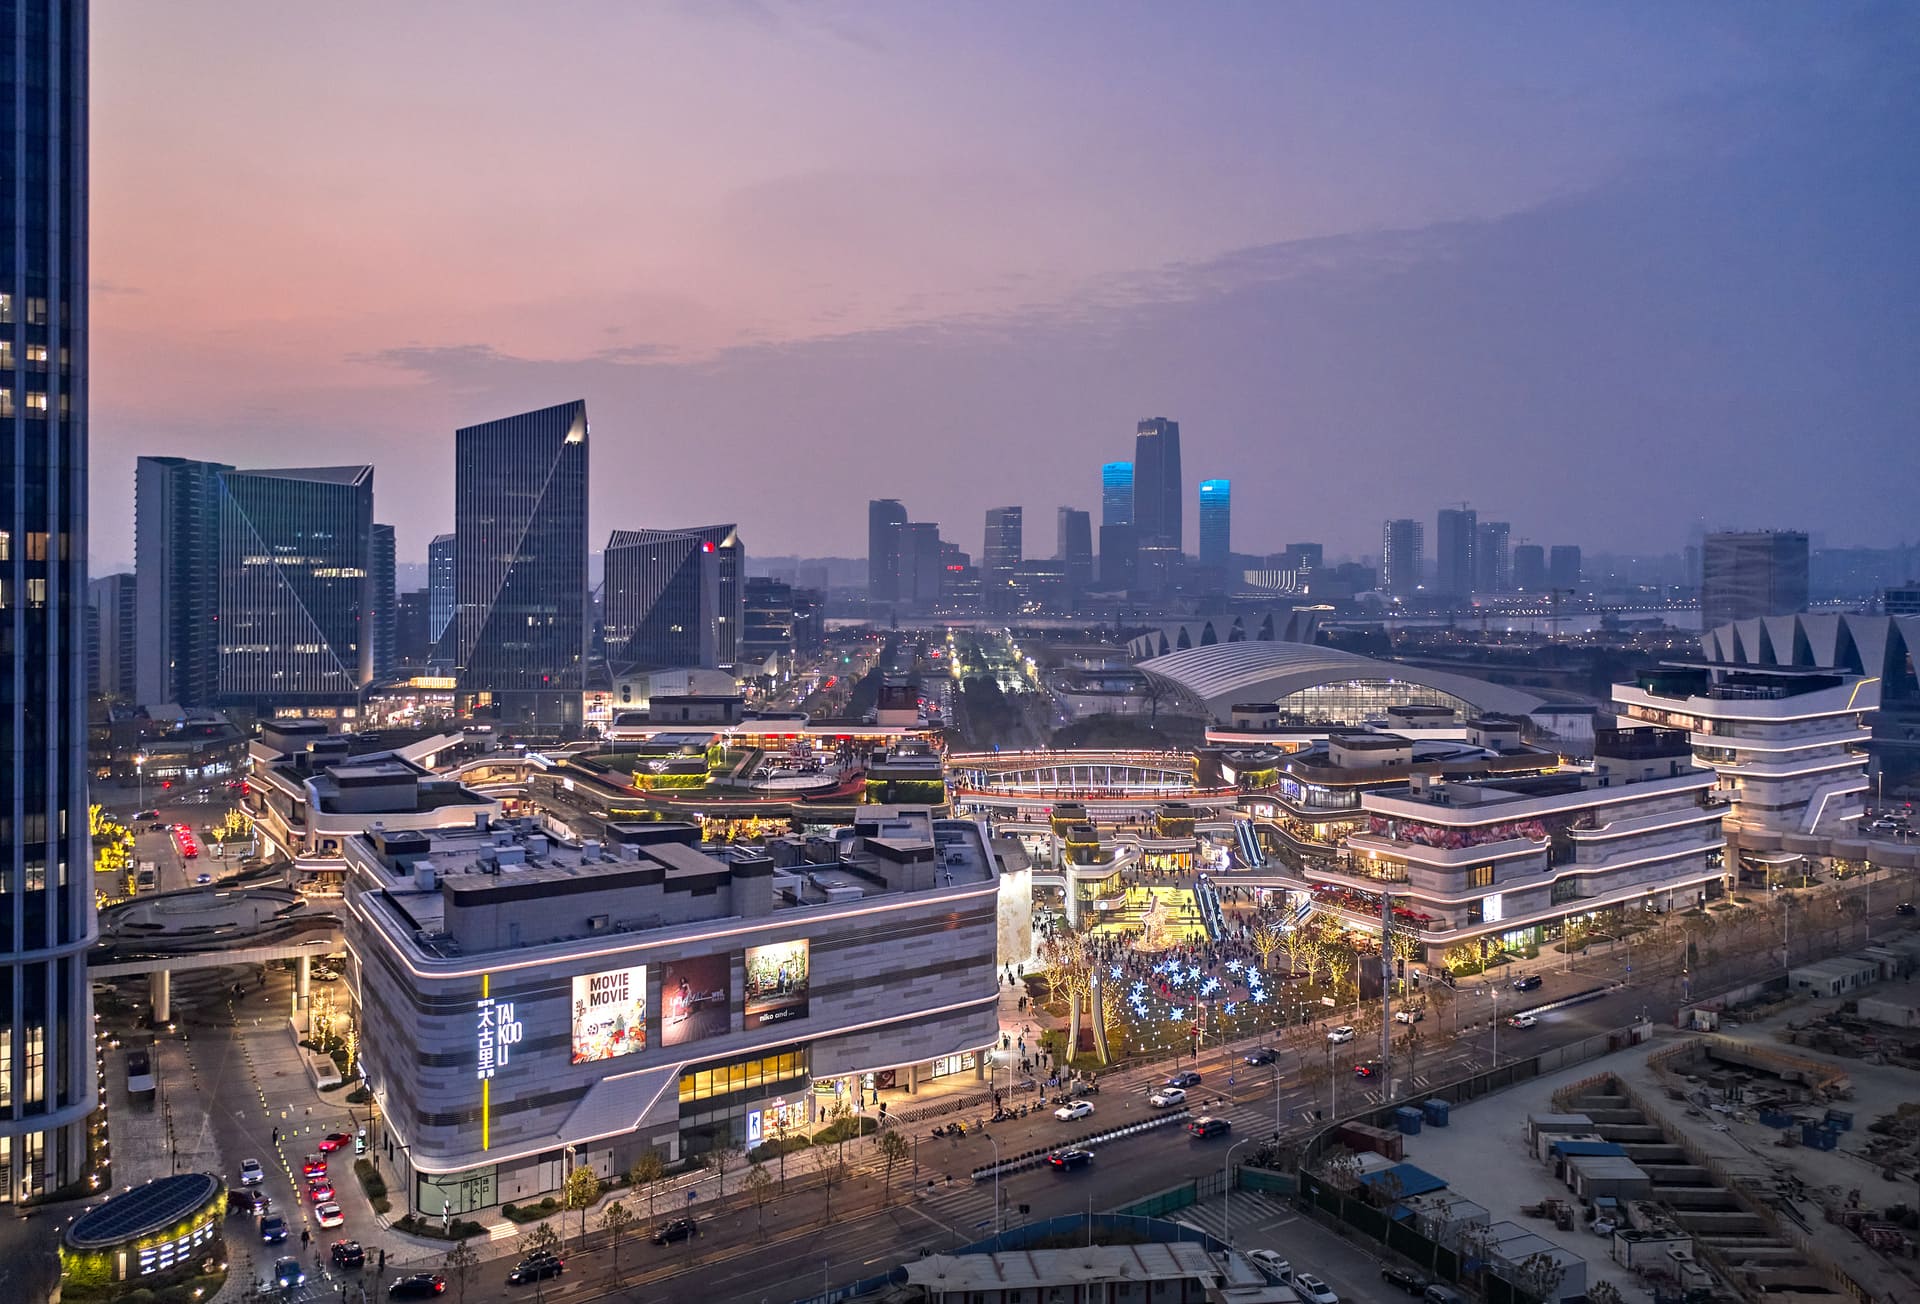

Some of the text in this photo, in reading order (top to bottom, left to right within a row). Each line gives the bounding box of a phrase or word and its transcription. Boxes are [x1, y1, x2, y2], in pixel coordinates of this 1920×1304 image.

[590, 973, 629, 991] MOVIE
[590, 988, 629, 1006] MOVIE
[495, 1003, 514, 1025] TAI
[760, 1013, 774, 1022] niko
[775, 1009, 788, 1019] and
[477, 1007, 495, 1070] 太古里
[498, 1021, 523, 1046] KOO
[498, 1044, 509, 1066] LI
